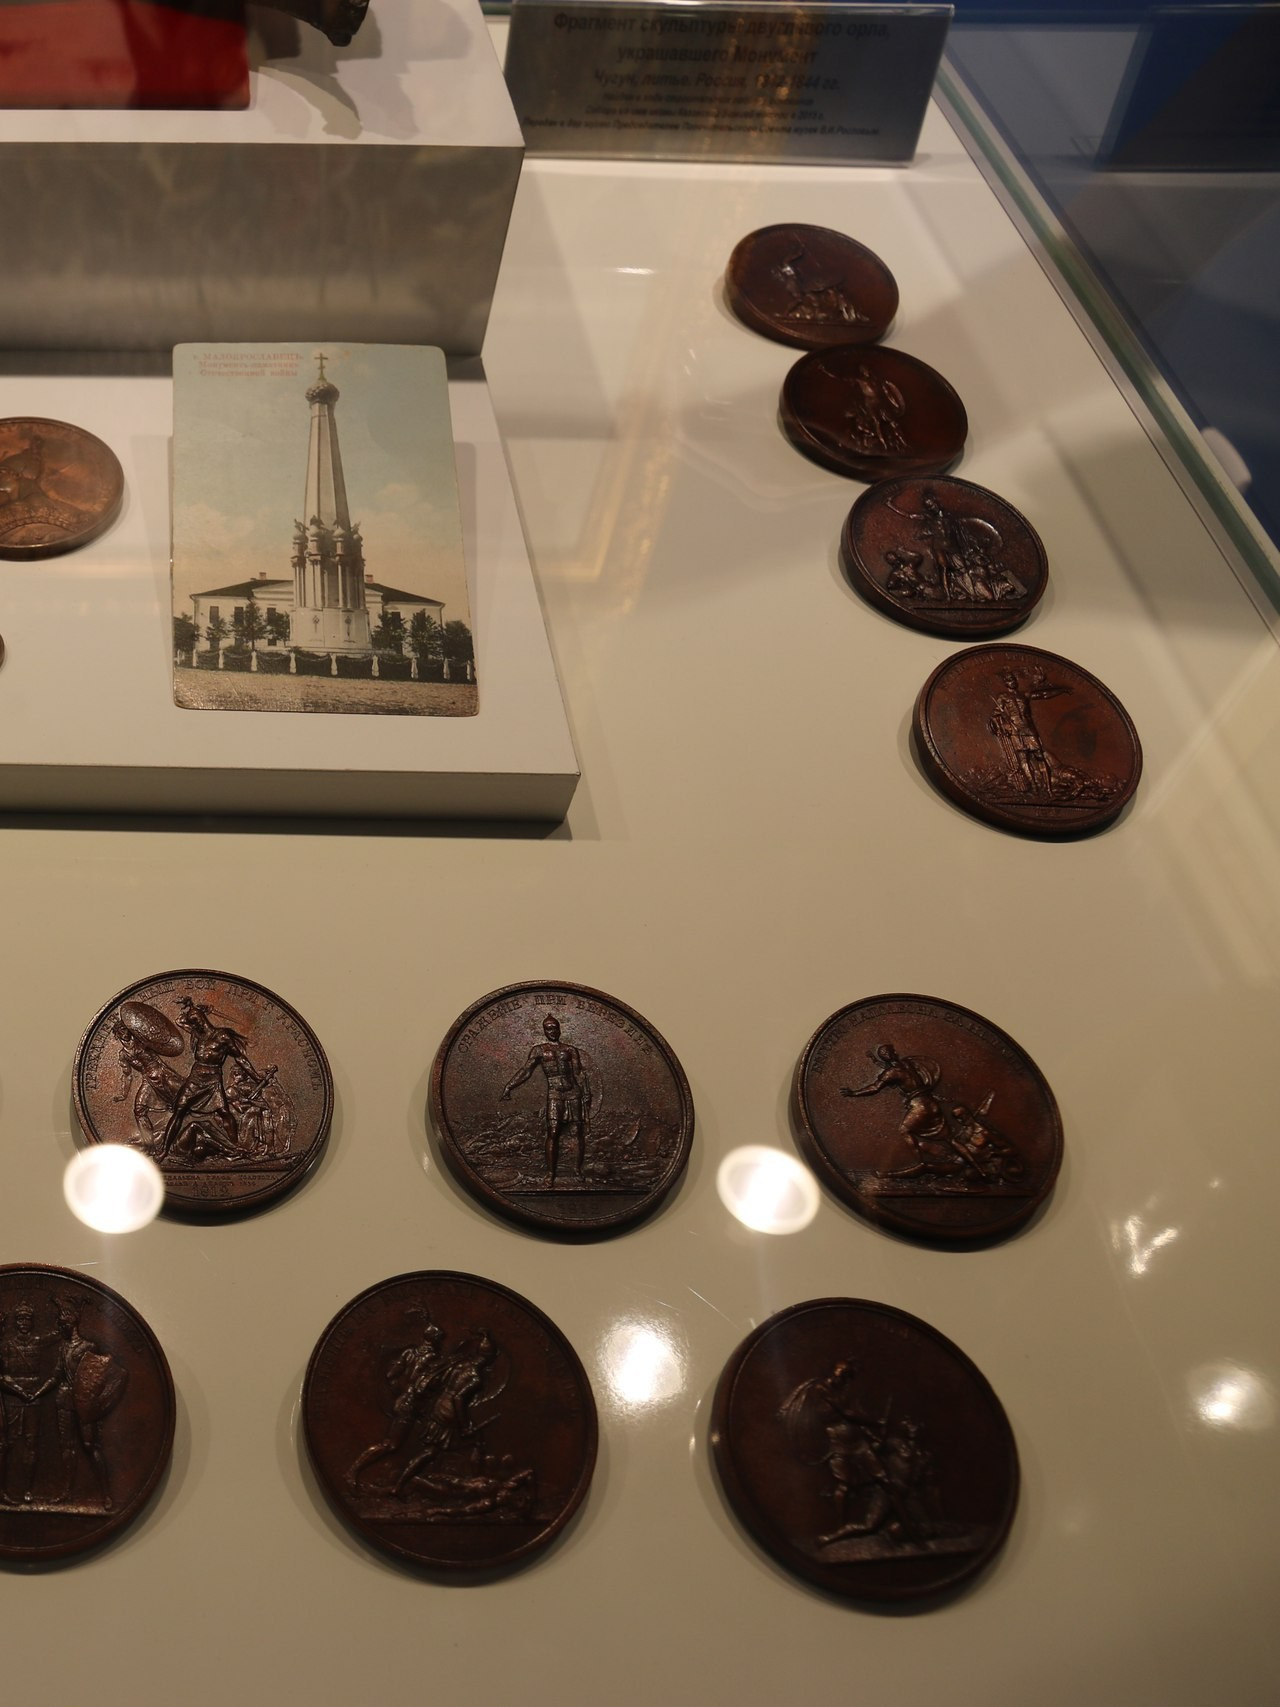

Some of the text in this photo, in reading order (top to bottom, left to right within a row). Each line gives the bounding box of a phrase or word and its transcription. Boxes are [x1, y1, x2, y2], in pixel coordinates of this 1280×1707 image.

[554, 12, 637, 33] Фрагмент
[639, 16, 743, 37] скульптуры
[845, 22, 892, 40] орла,
[616, 46, 729, 63] украшавшего
